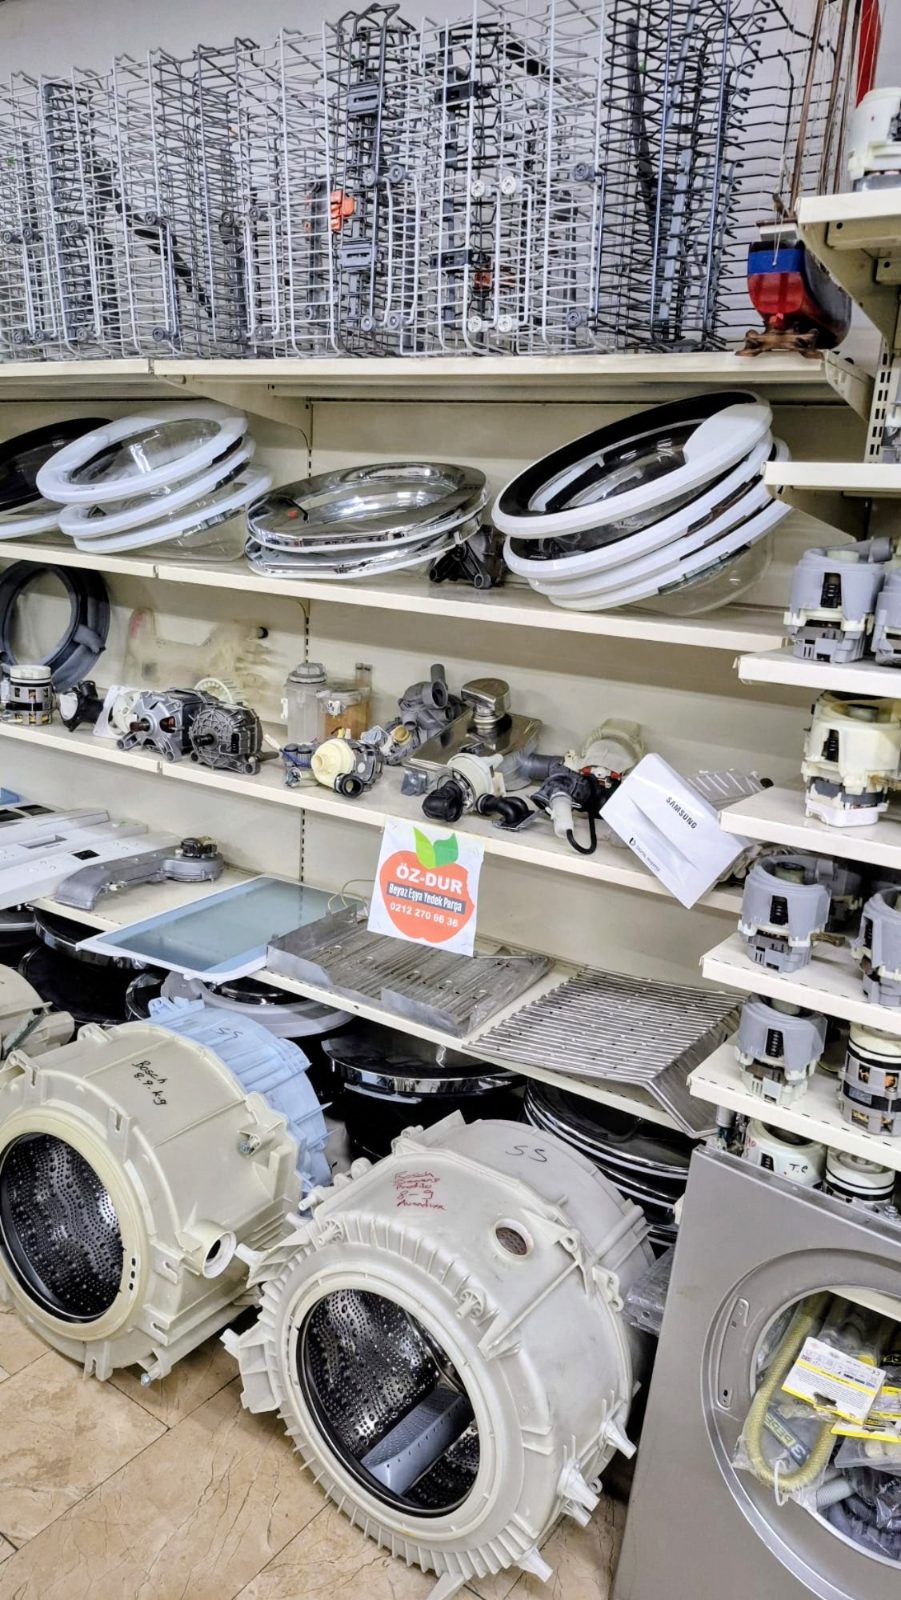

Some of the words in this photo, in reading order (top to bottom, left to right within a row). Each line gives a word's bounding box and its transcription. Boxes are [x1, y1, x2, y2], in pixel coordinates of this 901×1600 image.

[665, 796, 698, 829] SAMSUNG
[396, 862, 463, 895] ÖZ-DUR
[389, 883, 408, 896] Beyaz
[424, 892, 442, 907] Yedek
[390, 903, 413, 916] 0212
[414, 908, 432, 920] 270
